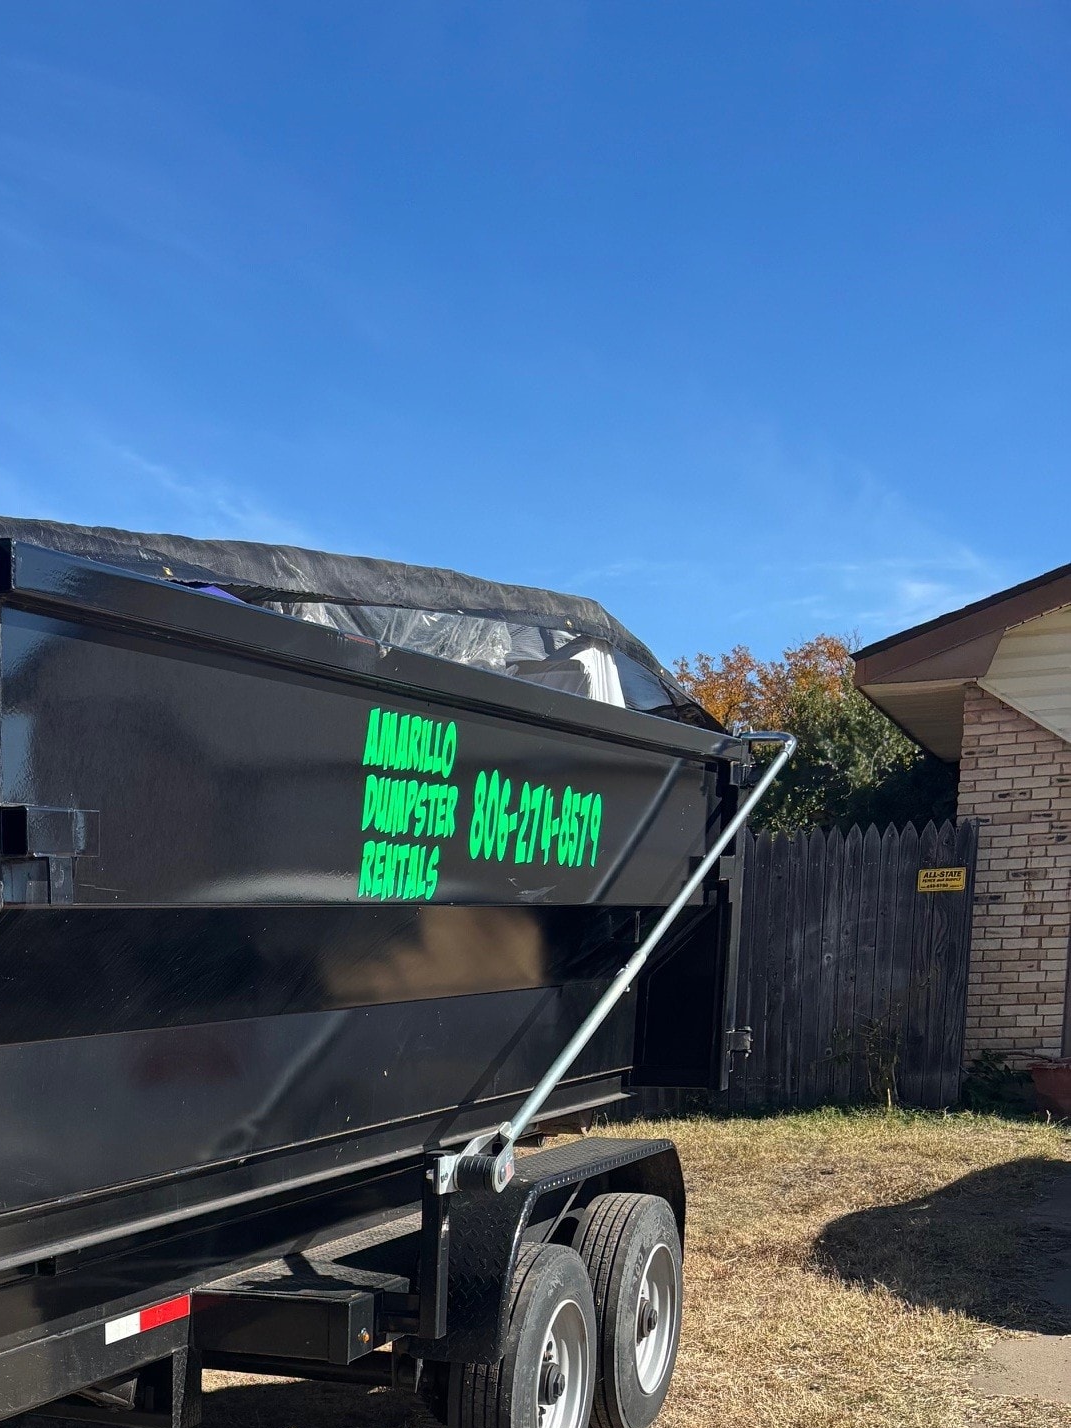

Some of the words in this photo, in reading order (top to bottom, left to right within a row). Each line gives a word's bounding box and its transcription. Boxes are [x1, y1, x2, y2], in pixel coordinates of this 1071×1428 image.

[362, 707, 458, 779] AMARILLO
[361, 774, 459, 838] DUMPSTER
[469, 769, 602, 868] 806-274-8579
[357, 840, 440, 901] RENTALS
[923, 870, 962, 878] ALL-STATE
